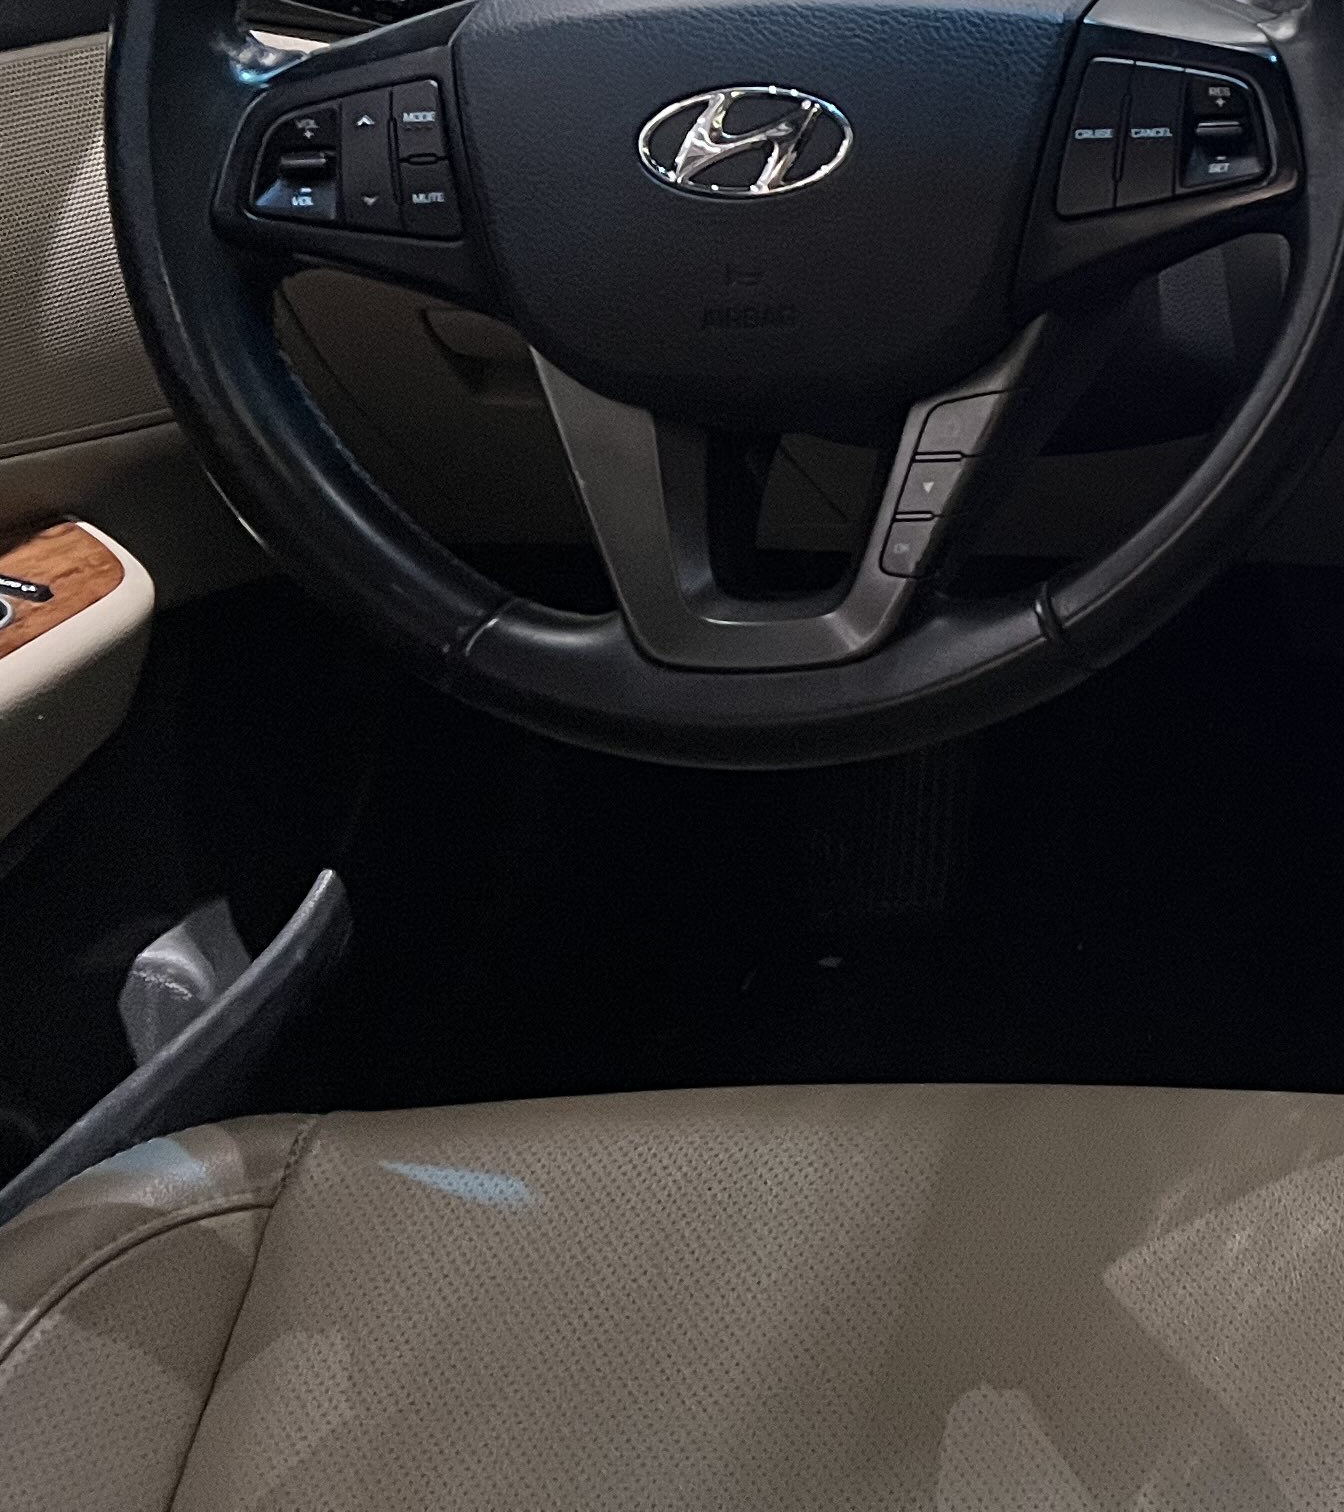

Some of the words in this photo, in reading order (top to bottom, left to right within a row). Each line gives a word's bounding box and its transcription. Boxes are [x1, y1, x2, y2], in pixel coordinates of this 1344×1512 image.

[402, 111, 436, 122] MODE
[1131, 127, 1173, 138] CANCEL
[291, 195, 315, 206] VOL
[411, 191, 445, 204] MUTE
